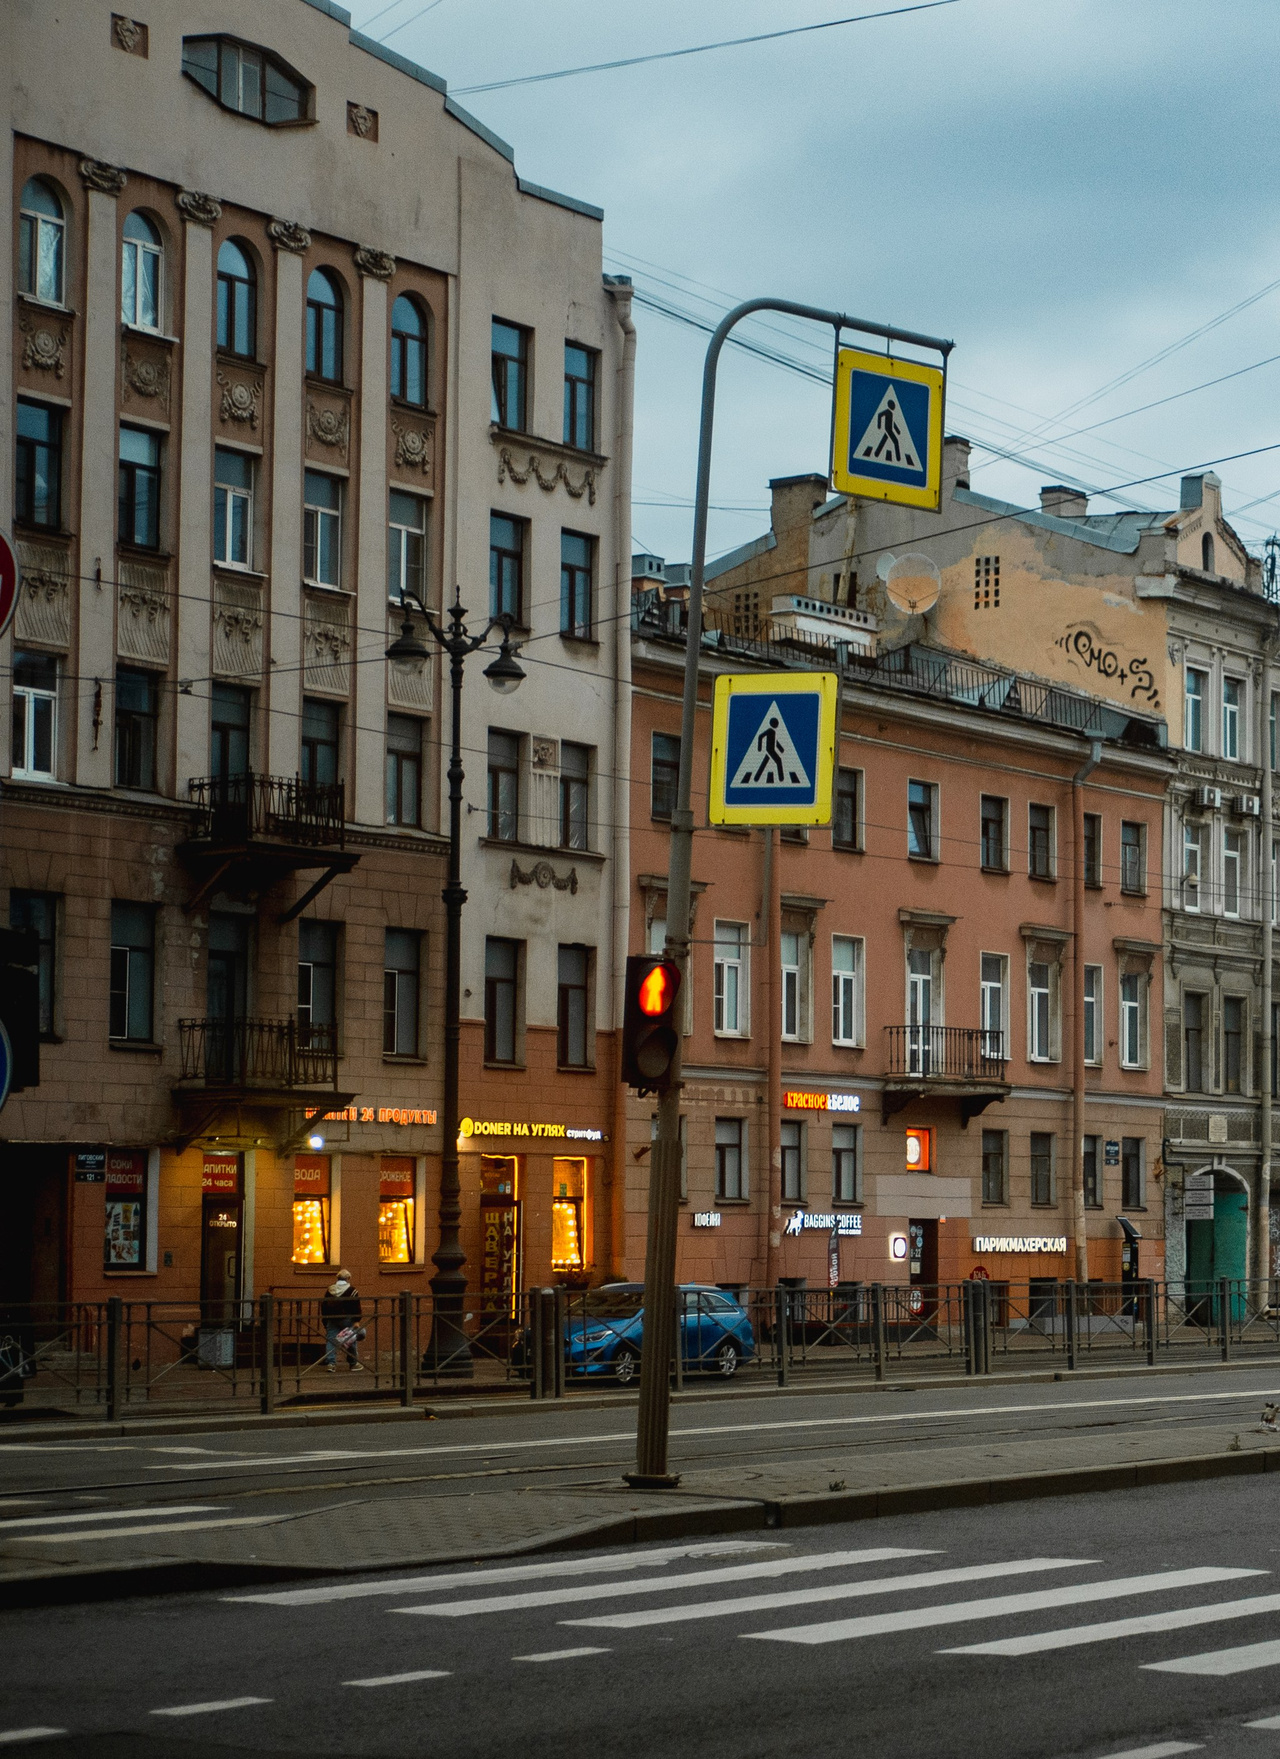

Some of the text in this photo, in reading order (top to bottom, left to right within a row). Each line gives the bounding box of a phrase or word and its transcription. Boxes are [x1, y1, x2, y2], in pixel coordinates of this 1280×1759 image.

[361, 1107, 374, 1121] 24
[378, 1108, 437, 1125] ПРОДУКТЫ
[474, 1121, 511, 1136] DONER
[513, 1123, 529, 1136] НА
[531, 1123, 565, 1137] УГЛЯХ
[111, 1159, 132, 1170] СОКИ
[203, 1164, 236, 1174] АПИТКИ
[86, 1173, 95, 1181] 121
[106, 1173, 142, 1185] ЛАДОСТИ
[295, 1169, 320, 1180] ВОДА
[380, 1171, 411, 1182] ОРОЖЕНОЕ
[202, 1178, 212, 1187] 24
[218, 1213, 227, 1221] 24
[804, 1214, 862, 1228] BAGGINS COFFEE
[503, 1212, 513, 1236] НА
[975, 1237, 1067, 1252] ПАРИКМАХЕРСКАЯ
